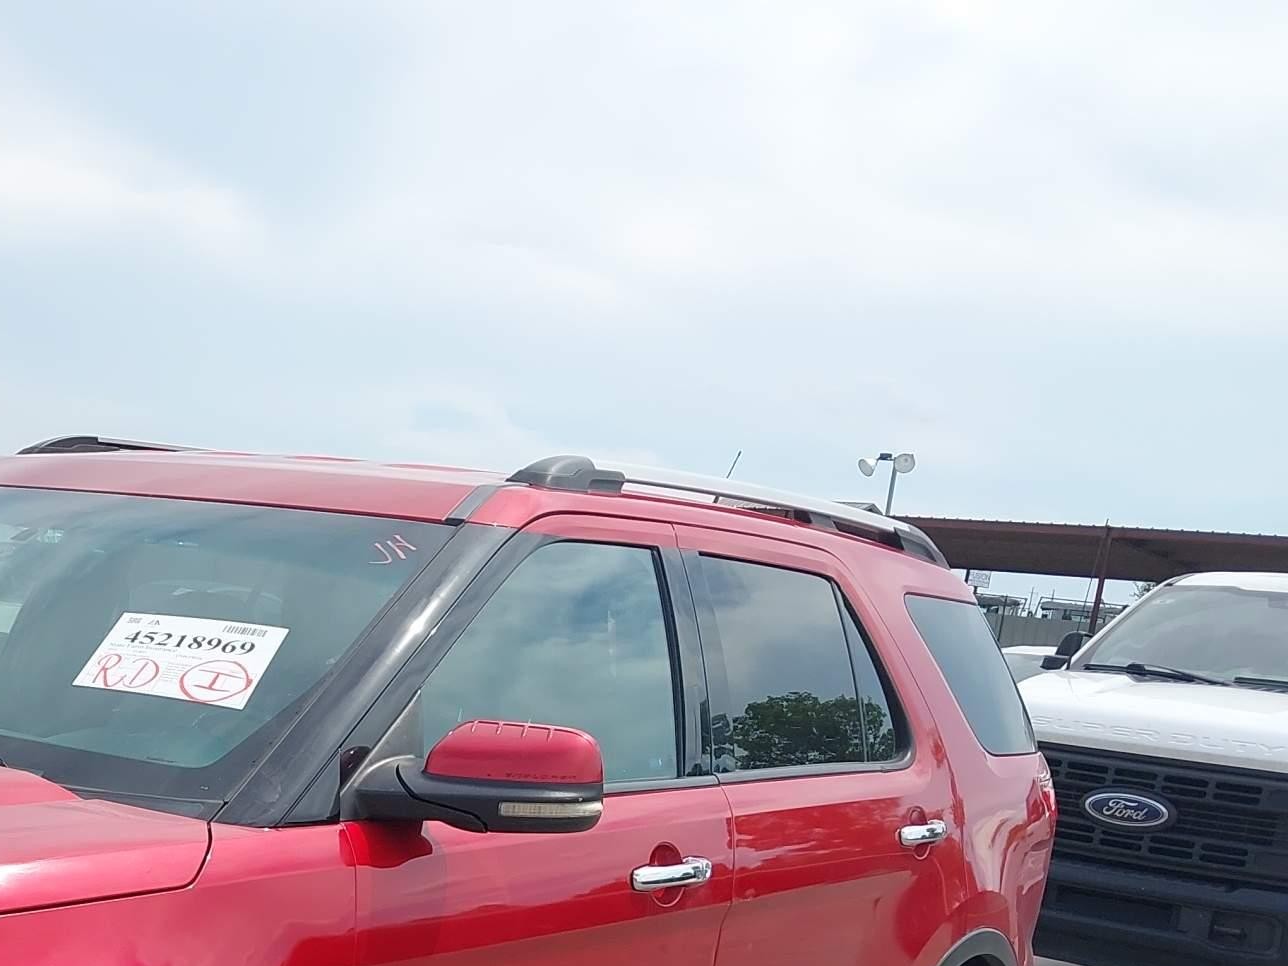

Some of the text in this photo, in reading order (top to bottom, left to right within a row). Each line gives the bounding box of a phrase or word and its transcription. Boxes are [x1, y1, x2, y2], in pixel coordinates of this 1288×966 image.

[124, 629, 257, 656] 45218969
[1031, 714, 1287, 757] SUPER DUTY
[1102, 798, 1148, 822] Ford
